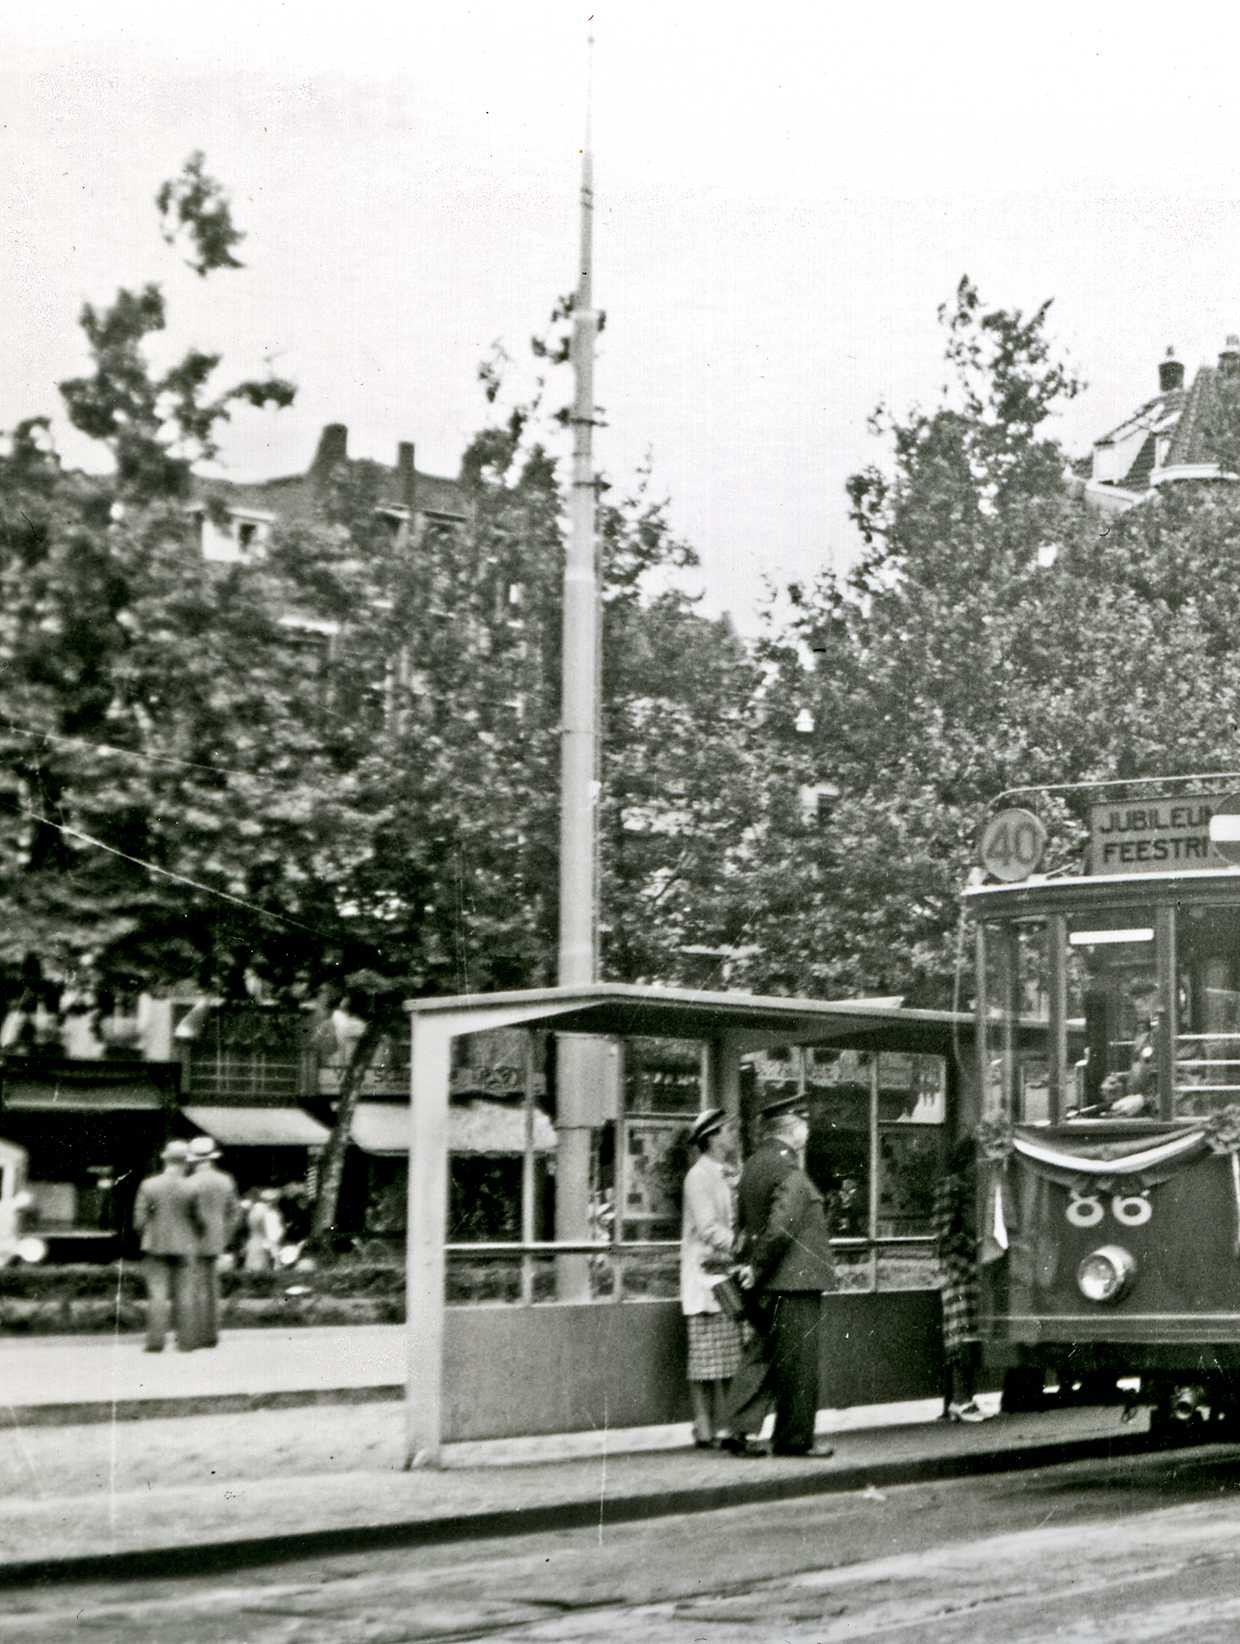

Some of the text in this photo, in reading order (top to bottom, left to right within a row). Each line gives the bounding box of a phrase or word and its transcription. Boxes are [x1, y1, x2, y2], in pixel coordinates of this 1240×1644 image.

[985, 821, 1039, 867] 40
[1102, 836, 1219, 865] FEESTRI
[1066, 1188, 1152, 1227] 86
